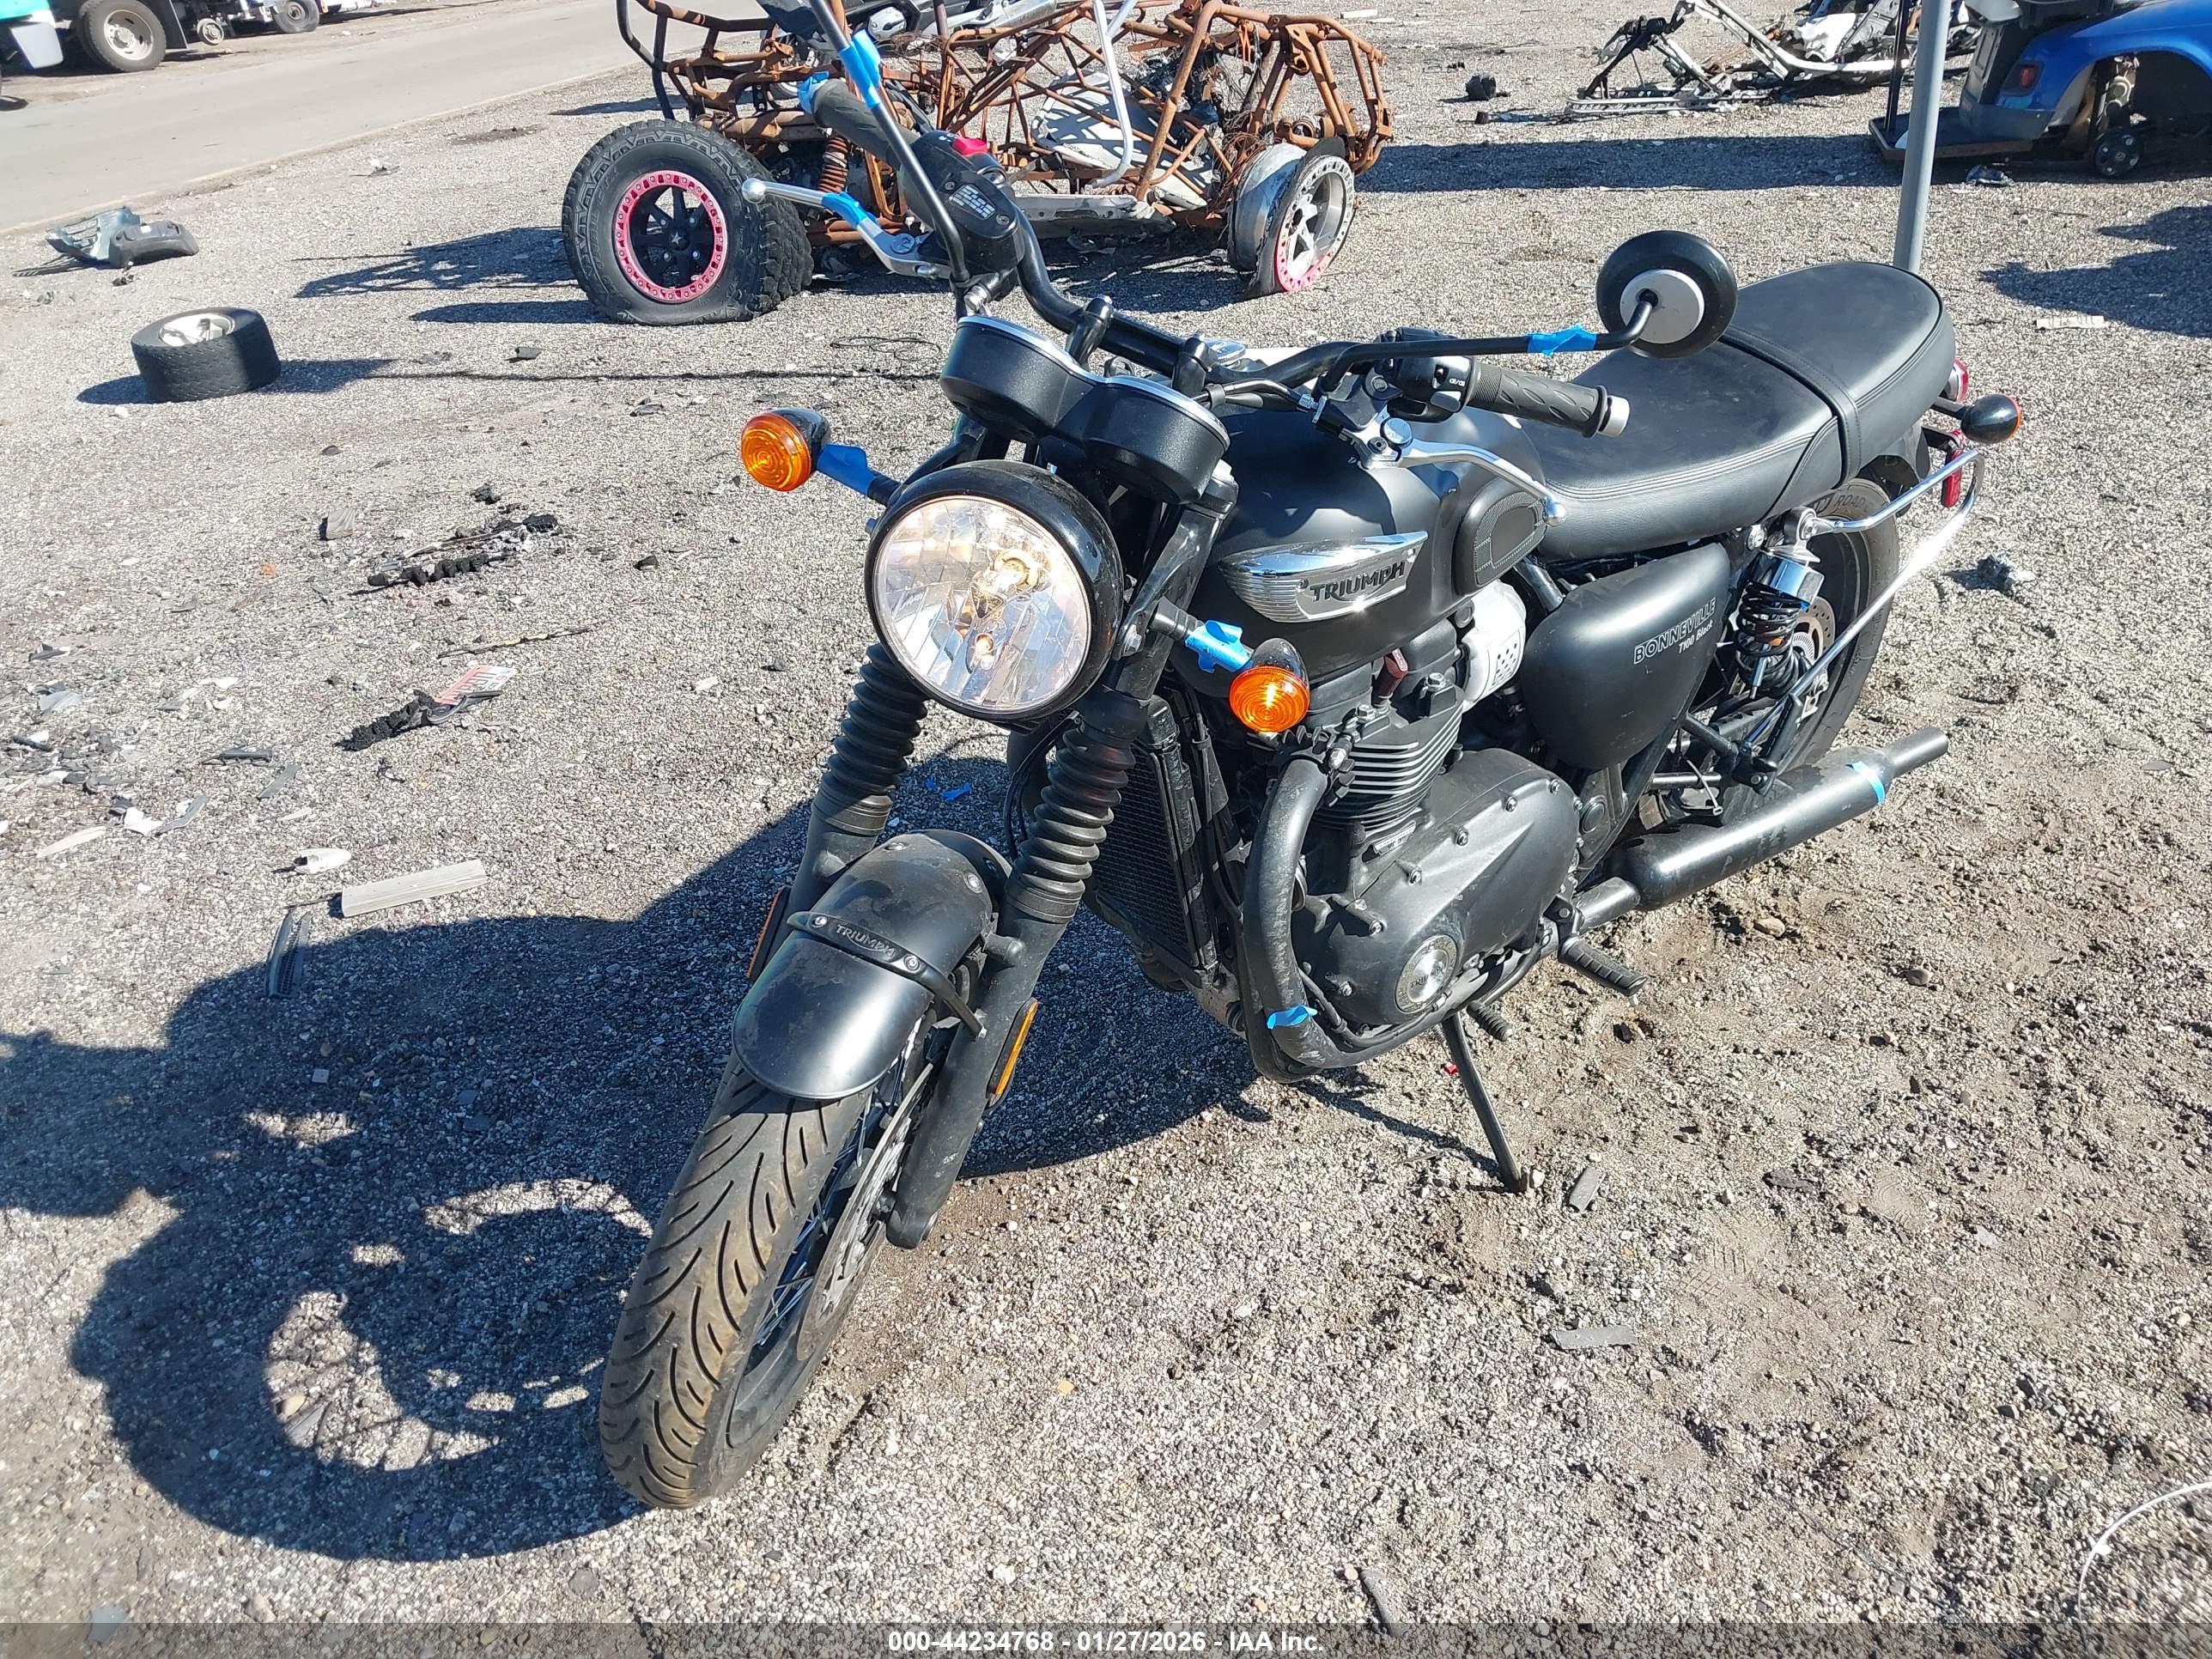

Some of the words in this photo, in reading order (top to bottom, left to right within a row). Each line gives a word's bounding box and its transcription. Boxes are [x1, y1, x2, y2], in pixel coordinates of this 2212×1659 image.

[1310, 561, 1405, 601] TRIUMPH
[1633, 597, 1717, 665] BONNEVILLE
[1678, 634, 1695, 653] T100
[1696, 618, 1714, 641] Black
[836, 924, 895, 957] TRIUMPH
